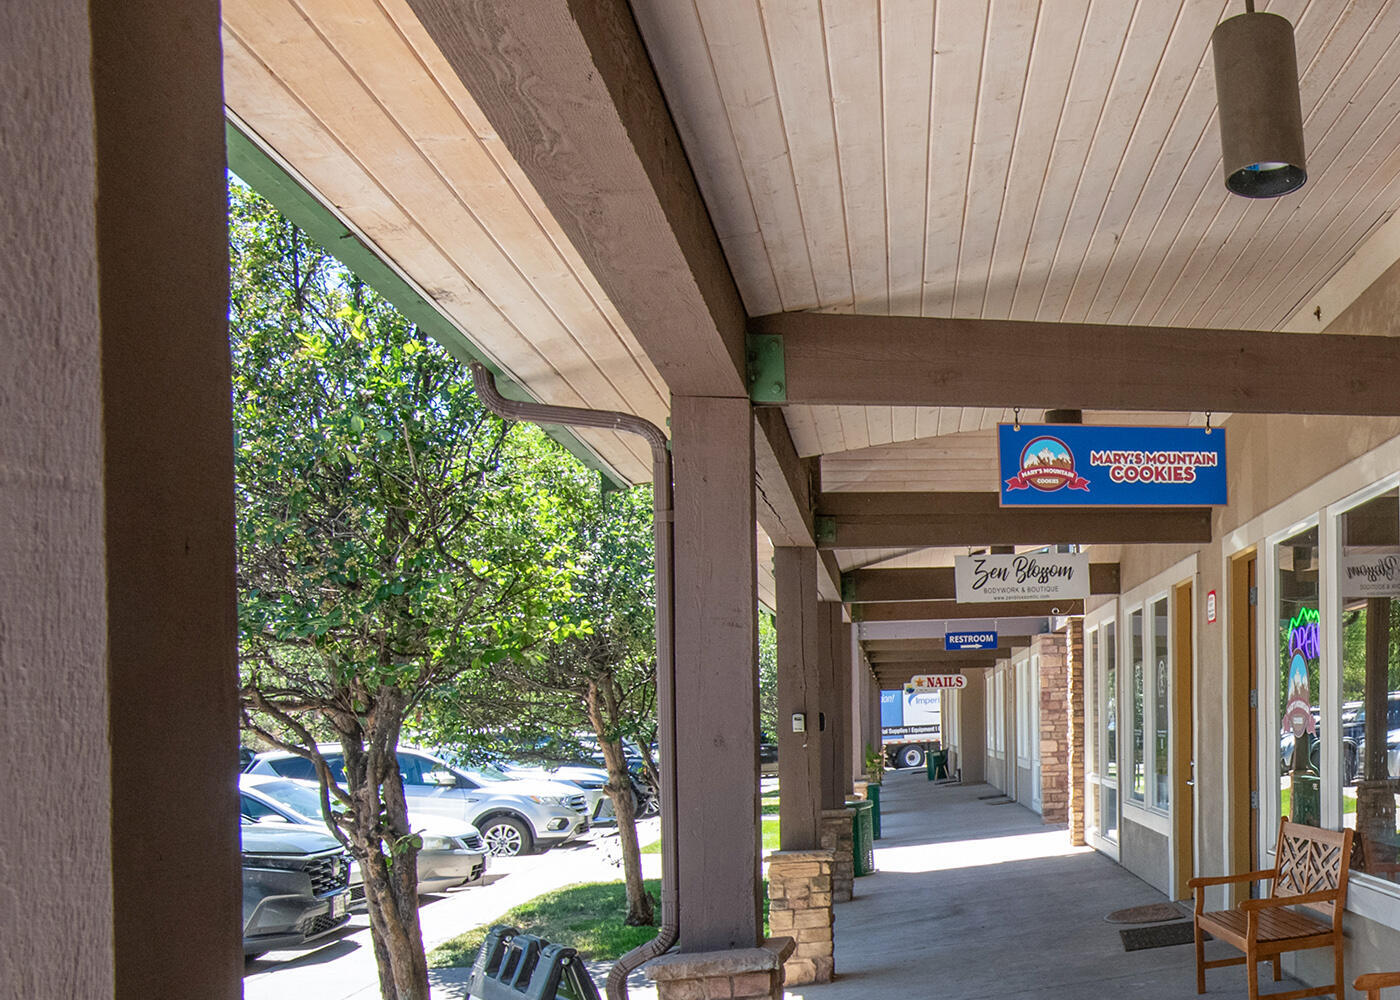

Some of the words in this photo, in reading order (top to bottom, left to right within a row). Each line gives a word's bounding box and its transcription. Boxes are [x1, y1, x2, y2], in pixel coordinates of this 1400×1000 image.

[1090, 451, 1143, 466] MARY'S
[1145, 451, 1217, 466] MOUNTAIN
[1021, 468, 1042, 478] MARY'S
[1043, 468, 1074, 478] MOUNTAIN
[1109, 464, 1196, 483] COOKIES
[972, 559, 1010, 590] Zen
[1012, 556, 1074, 584] Blossom
[949, 633, 994, 644] RESTROOM
[926, 676, 963, 688] NAILS
